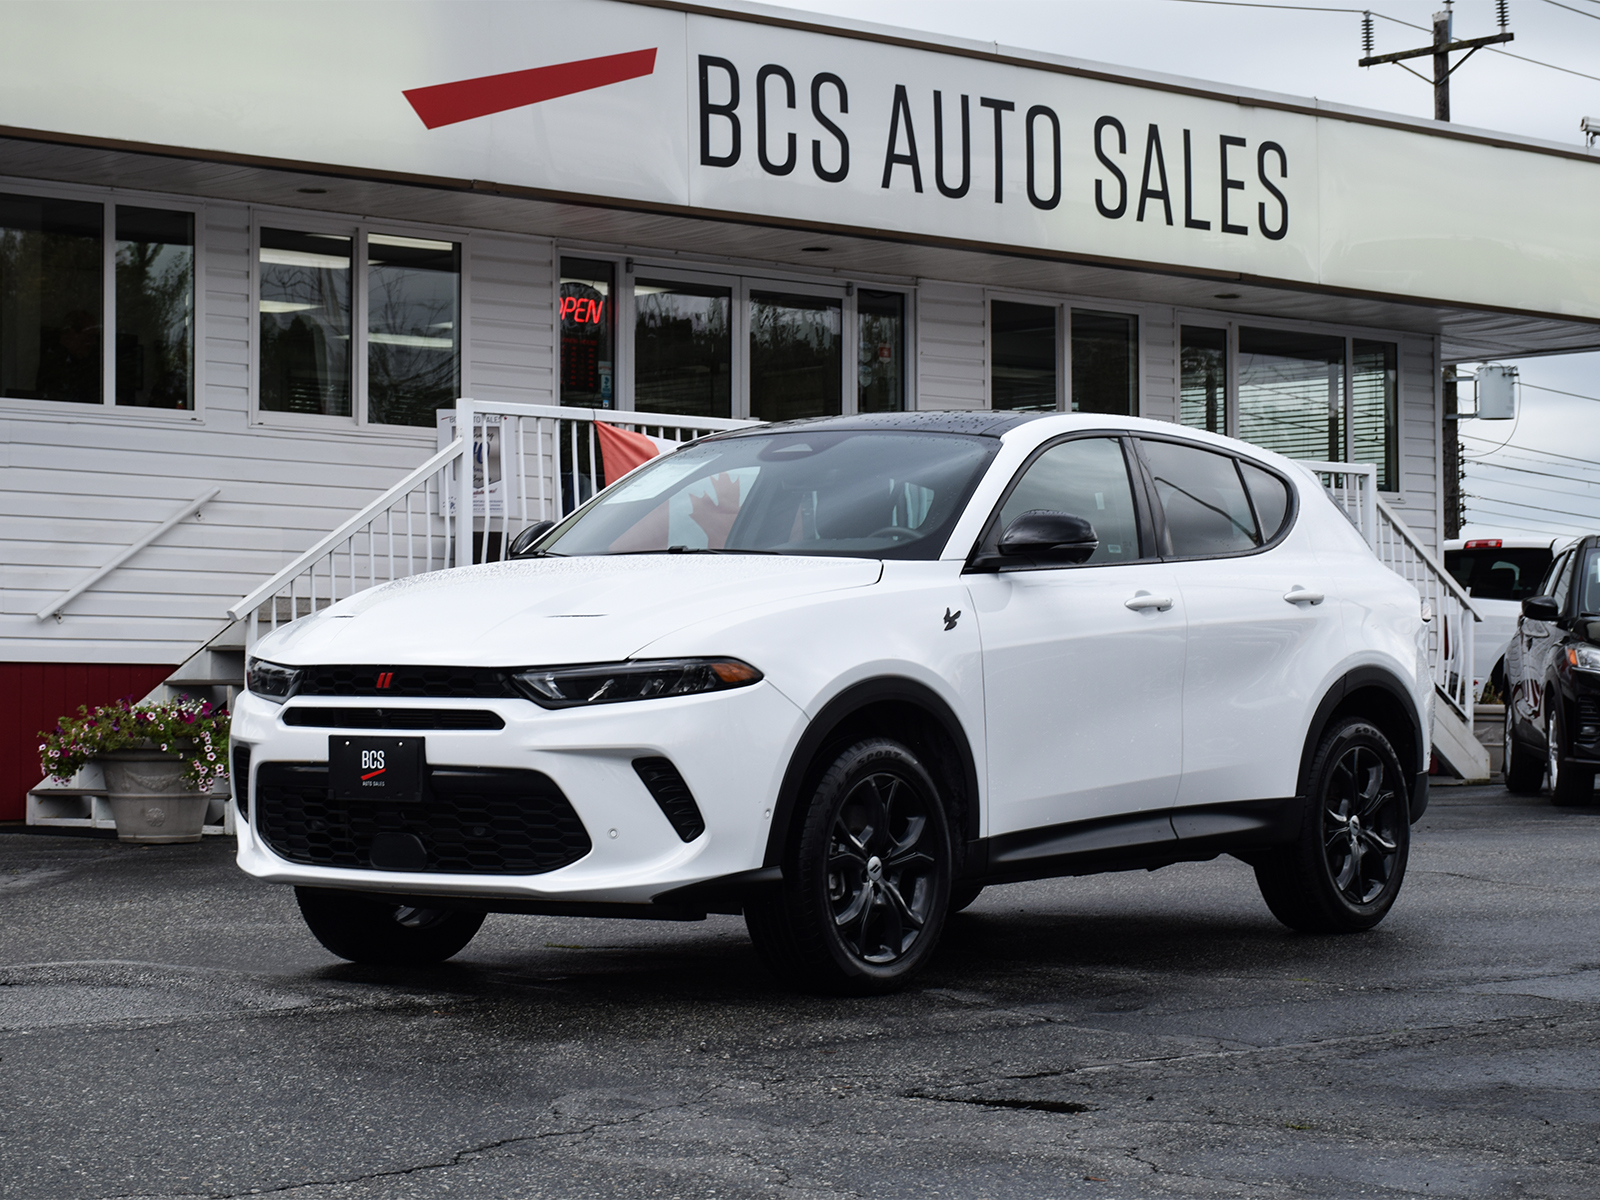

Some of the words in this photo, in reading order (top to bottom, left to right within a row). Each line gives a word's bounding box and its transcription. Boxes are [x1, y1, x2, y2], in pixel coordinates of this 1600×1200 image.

[699, 55, 849, 182] BCS
[882, 85, 1061, 210] AUTO
[1095, 116, 1288, 240] SALES
[361, 750, 385, 769] BCS
[857, 750, 902, 766] SPORT
